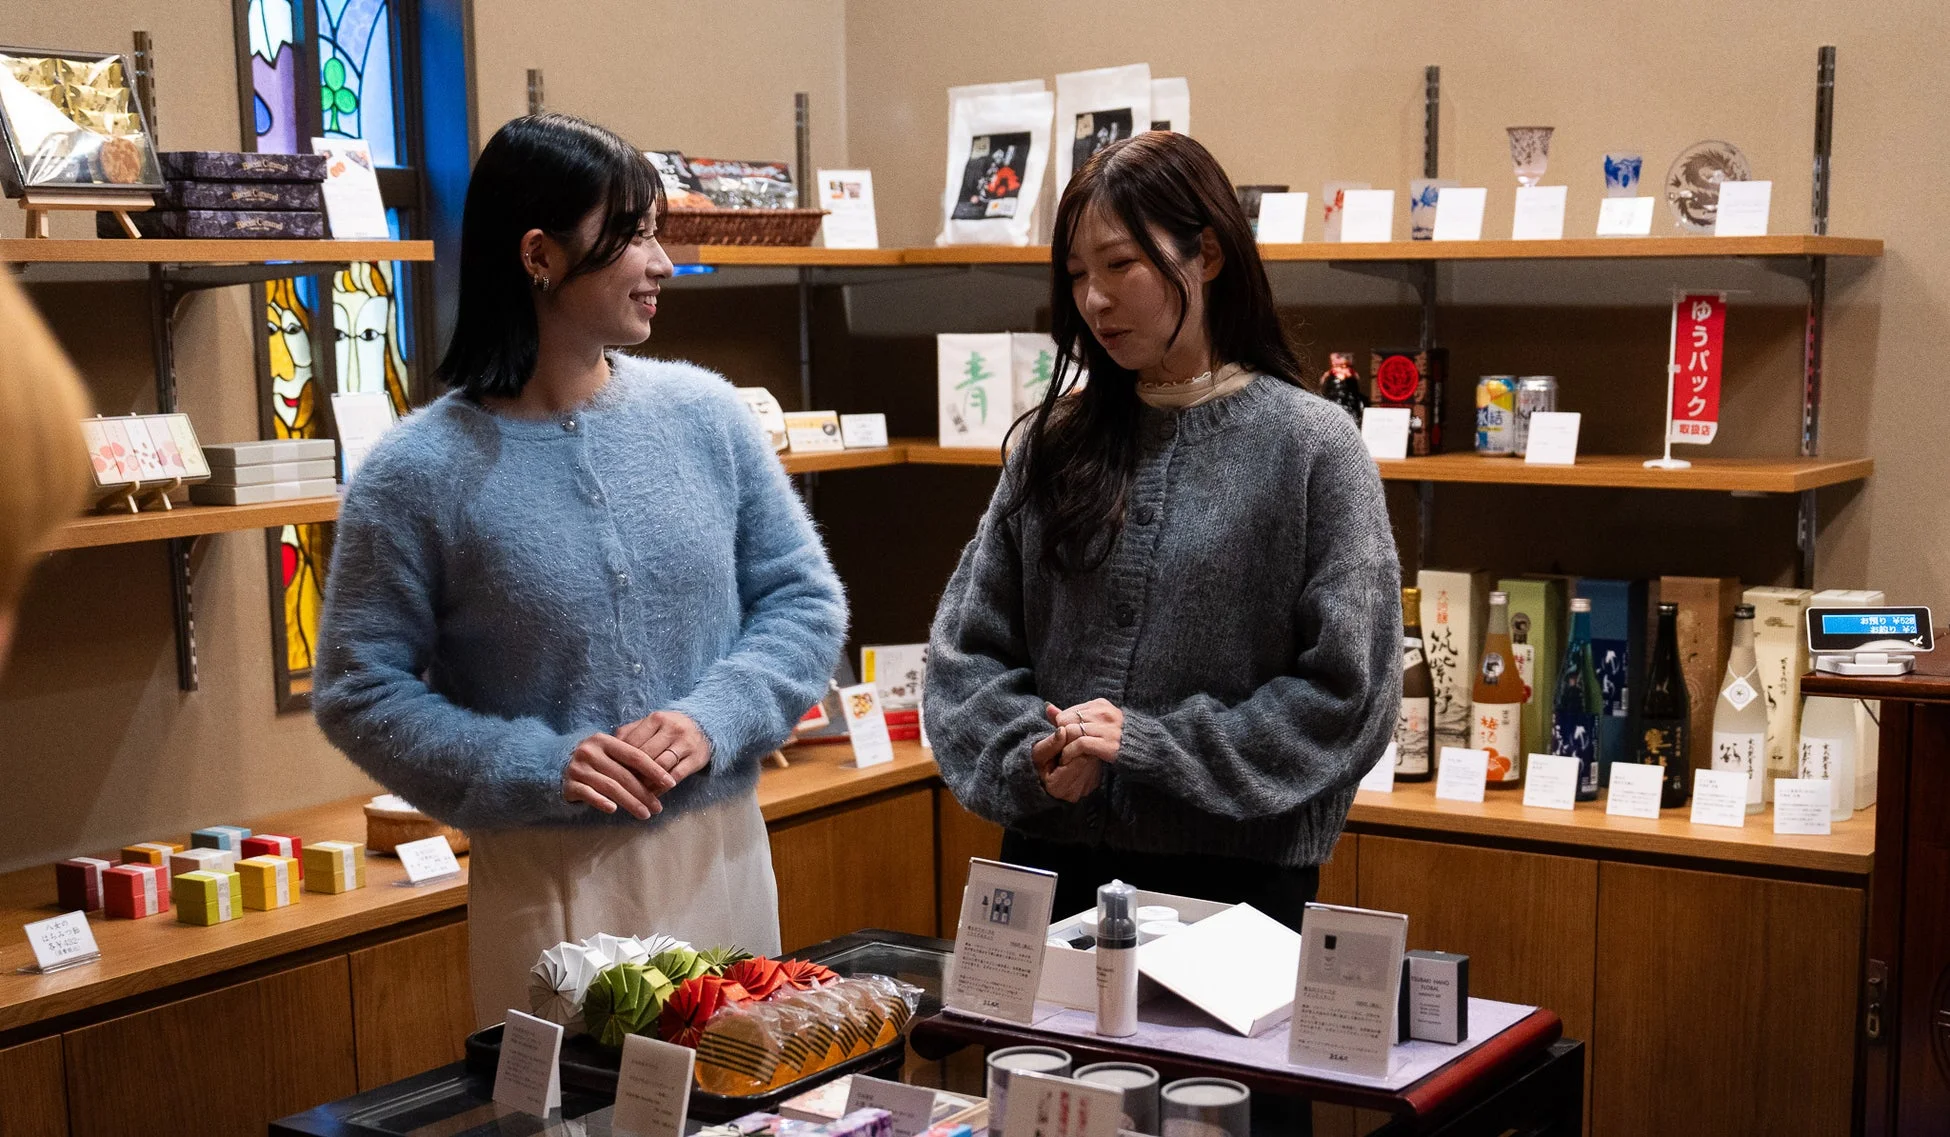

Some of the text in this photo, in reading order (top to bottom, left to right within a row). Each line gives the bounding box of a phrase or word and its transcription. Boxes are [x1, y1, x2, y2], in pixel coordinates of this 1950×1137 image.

[1687, 301, 1712, 417] ゆうパック
[954, 350, 995, 425] 青
[1679, 423, 1711, 436] 取扱店
[1860, 616, 1887, 625] お預り
[46, 920, 69, 931] 八女の
